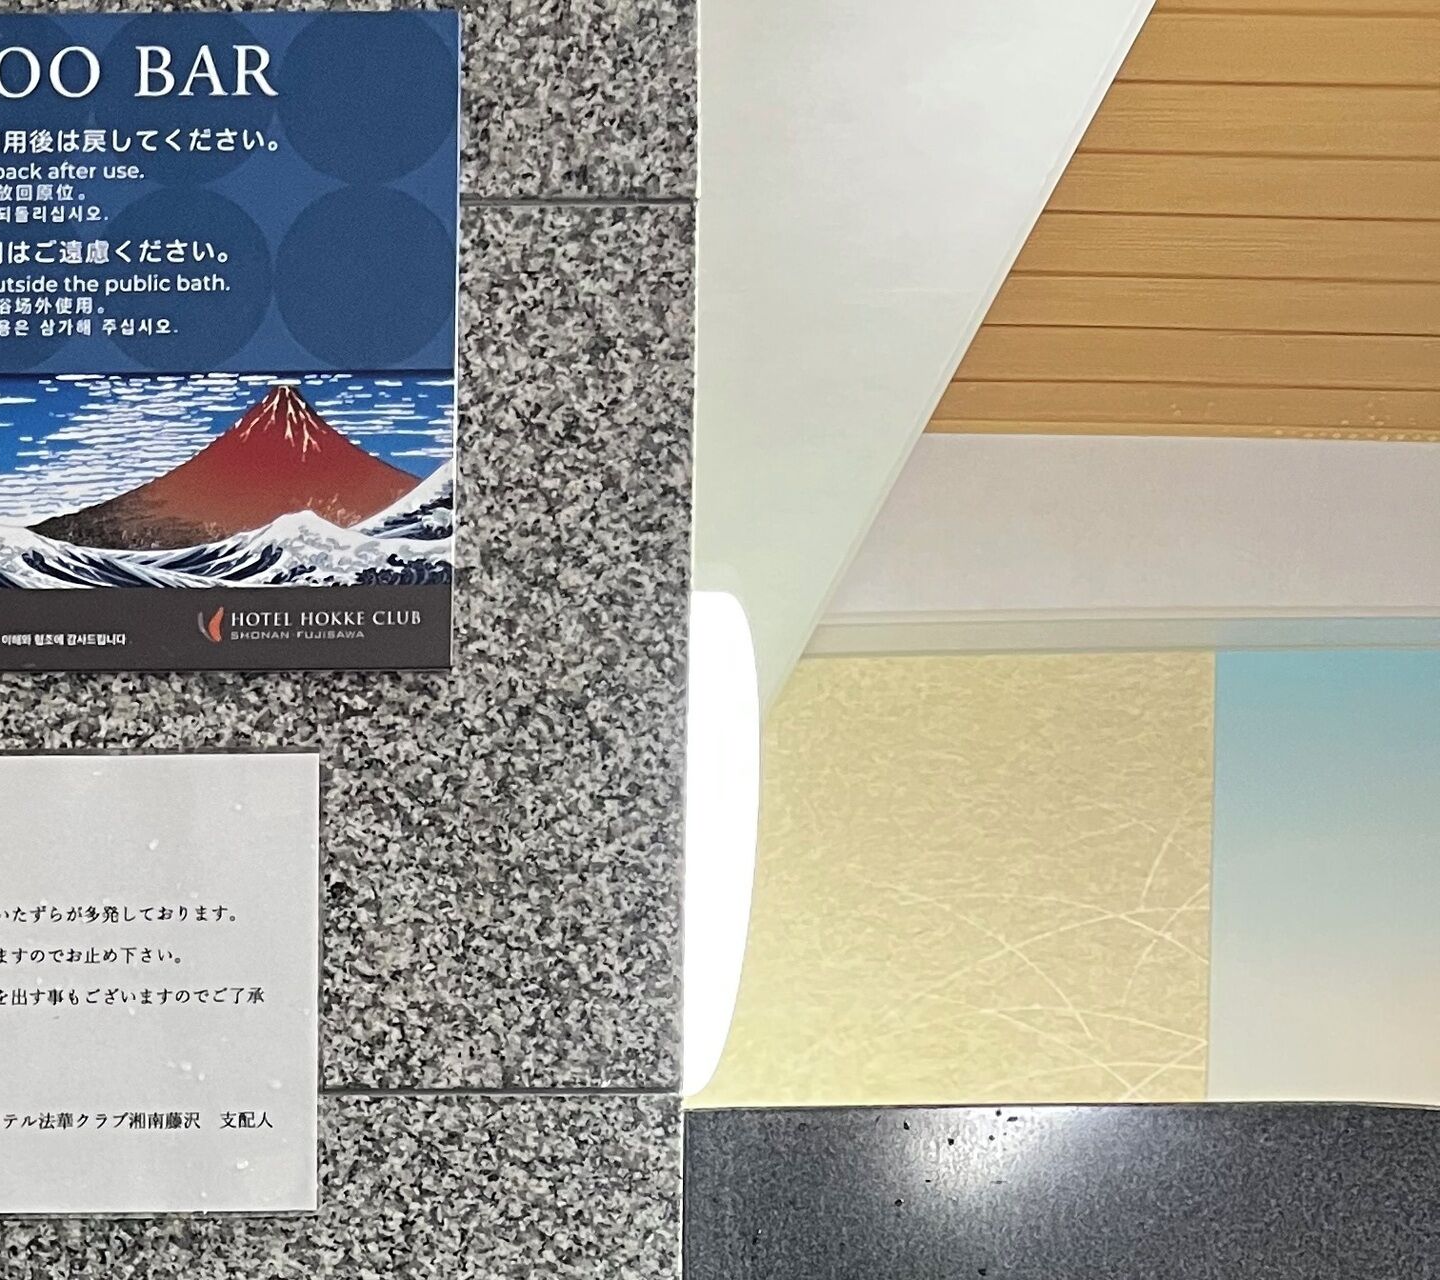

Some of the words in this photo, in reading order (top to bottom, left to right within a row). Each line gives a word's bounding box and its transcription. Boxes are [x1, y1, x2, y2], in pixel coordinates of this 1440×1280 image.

[134, 44, 279, 97] BAR
[47, 160, 97, 179] after
[103, 165, 145, 180] use.
[63, 274, 99, 293] the
[105, 274, 171, 295] public
[176, 273, 231, 292] bath.
[40, 318, 92, 337] 삼가해
[101, 318, 179, 336] 주십시오.
[230, 612, 292, 627] HOTEL
[300, 611, 365, 626] HOKKE
[372, 610, 421, 625] CLUB
[230, 630, 290, 640] SHONAN
[296, 630, 365, 640] FUJISAWA
[219, 1111, 274, 1129] 支配人
